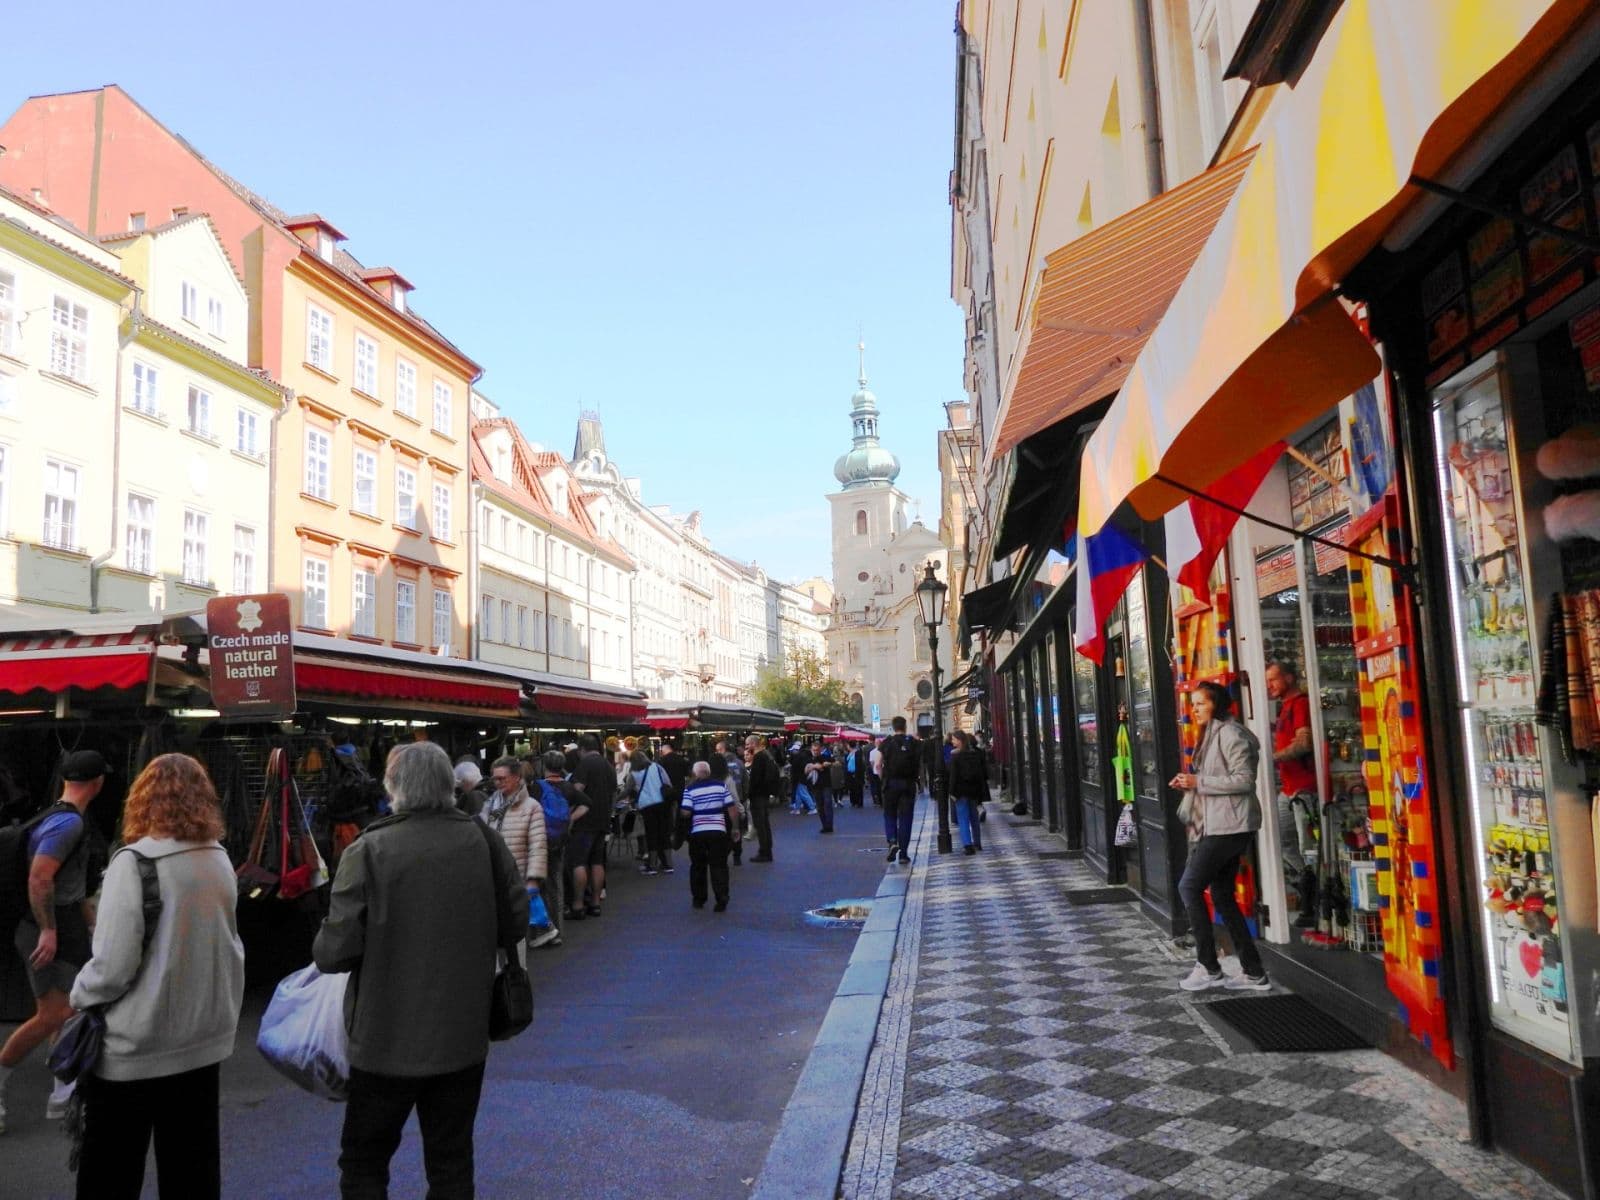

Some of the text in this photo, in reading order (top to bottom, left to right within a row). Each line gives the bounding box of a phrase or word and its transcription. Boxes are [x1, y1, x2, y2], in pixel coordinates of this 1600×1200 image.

[211, 631, 289, 648] Czech made
[225, 646, 278, 664] natural
[225, 663, 278, 680] leather
